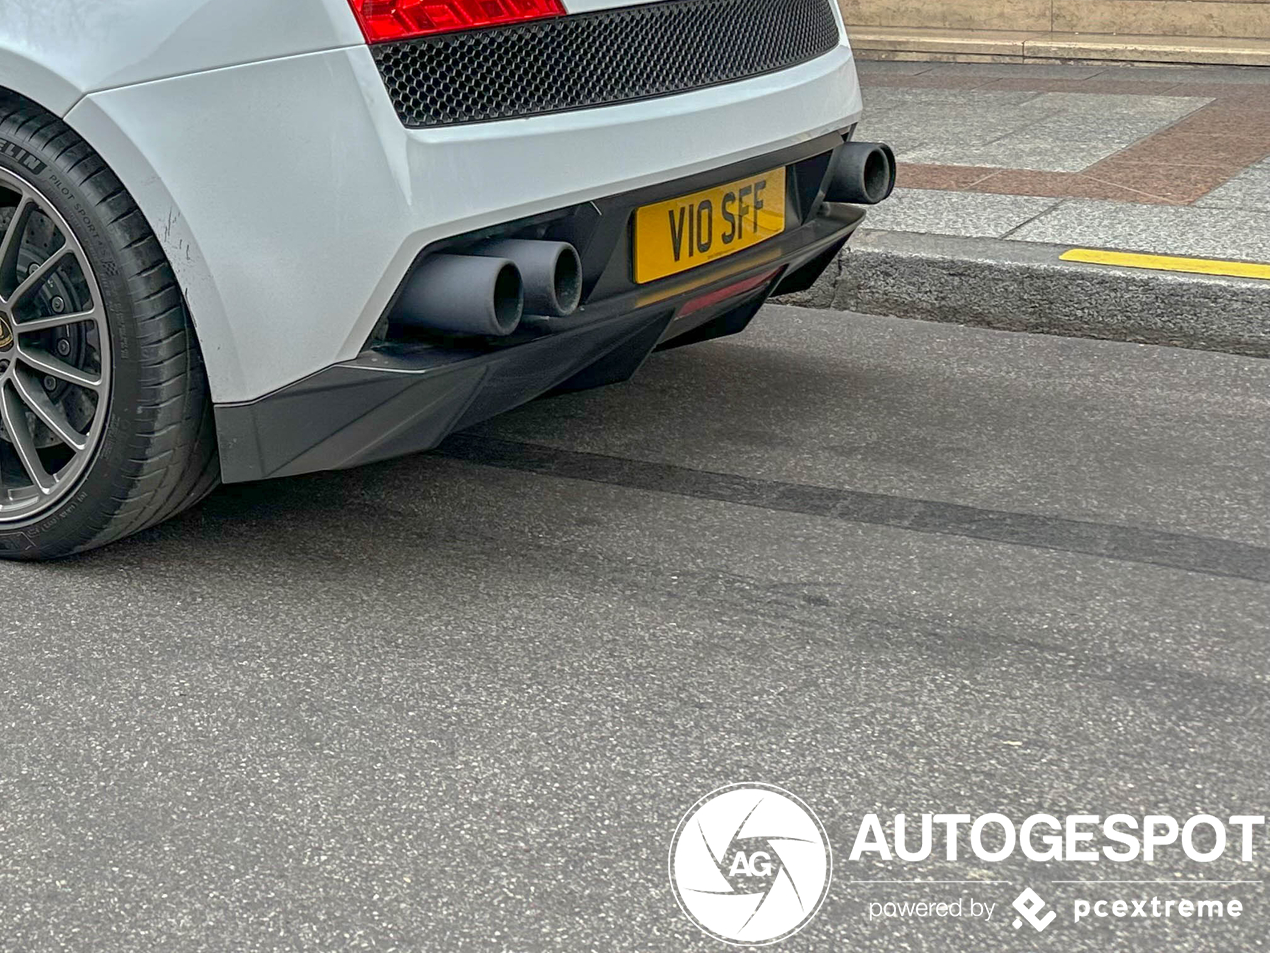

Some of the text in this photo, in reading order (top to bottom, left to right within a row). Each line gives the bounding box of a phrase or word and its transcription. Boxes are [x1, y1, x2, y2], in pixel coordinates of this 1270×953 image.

[49, 174, 76, 203] PILOT
[73, 202, 100, 239] SPORT
[668, 179, 767, 262] V10 SFF
